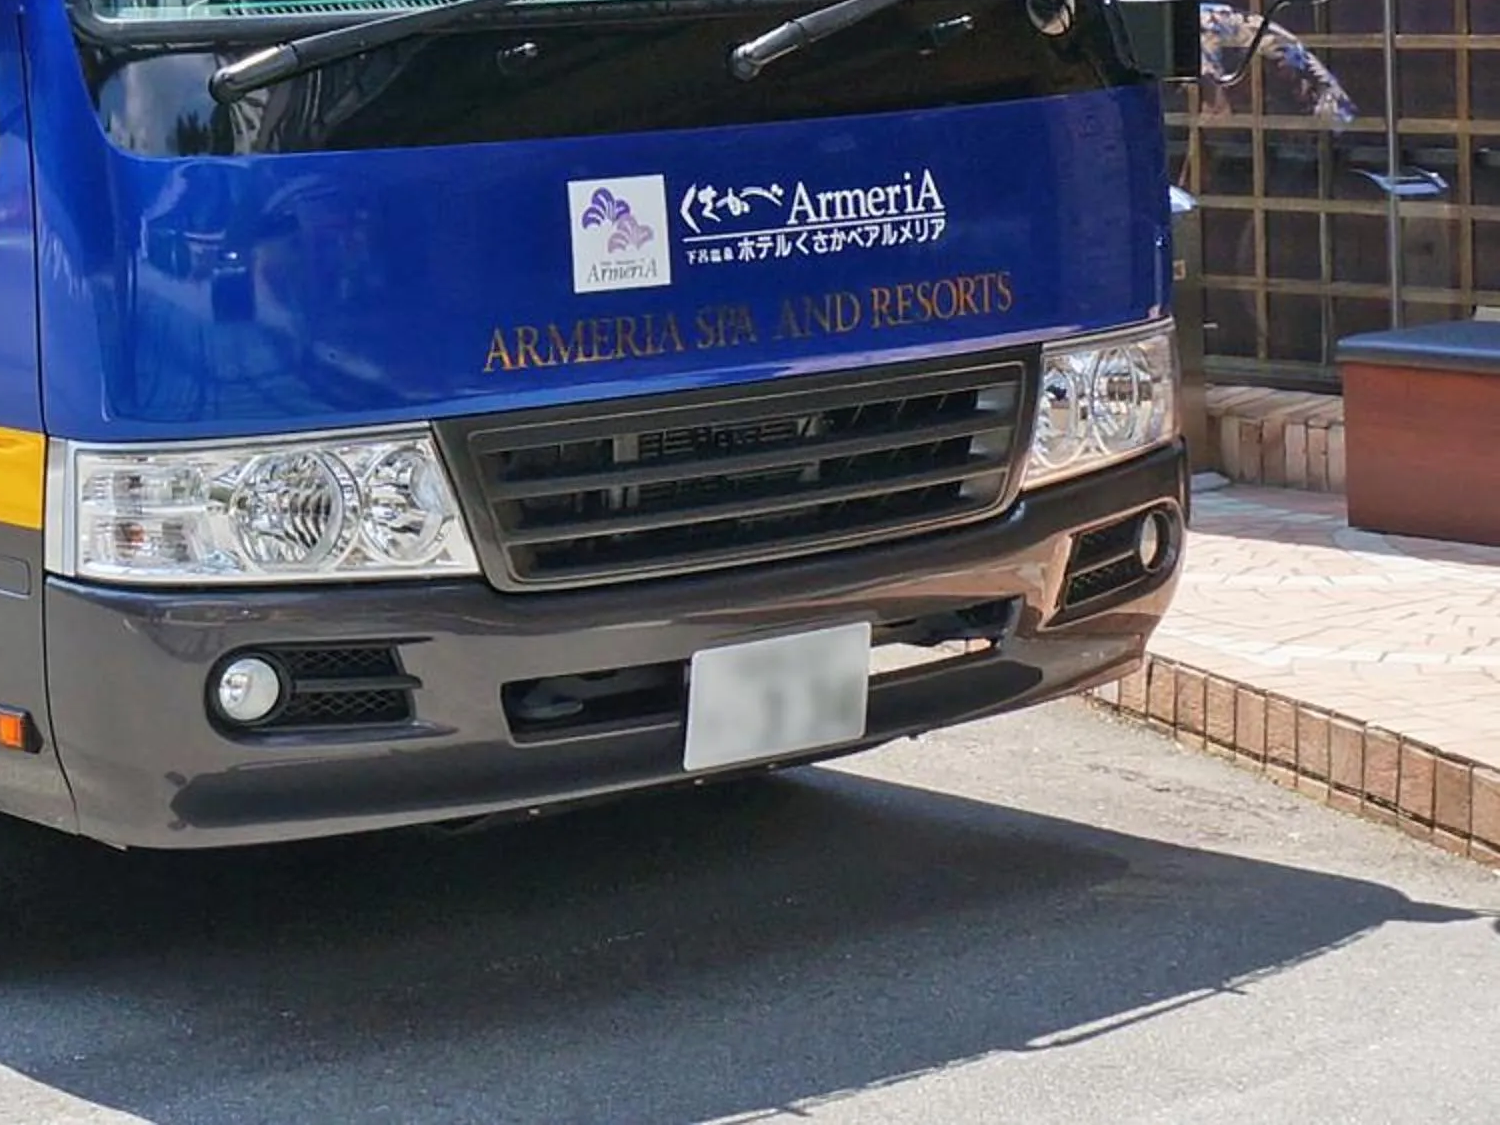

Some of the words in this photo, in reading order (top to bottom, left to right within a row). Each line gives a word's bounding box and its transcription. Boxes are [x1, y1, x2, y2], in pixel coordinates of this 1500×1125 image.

[786, 168, 946, 226] ArmeriA
[737, 217, 946, 263] ホテルくさかべアルメリア
[587, 257, 660, 284] ArmeriA
[483, 312, 683, 372] ARMERIA
[696, 304, 758, 351] SPA
[772, 291, 861, 341] AND
[870, 269, 1014, 329] RESORTS
